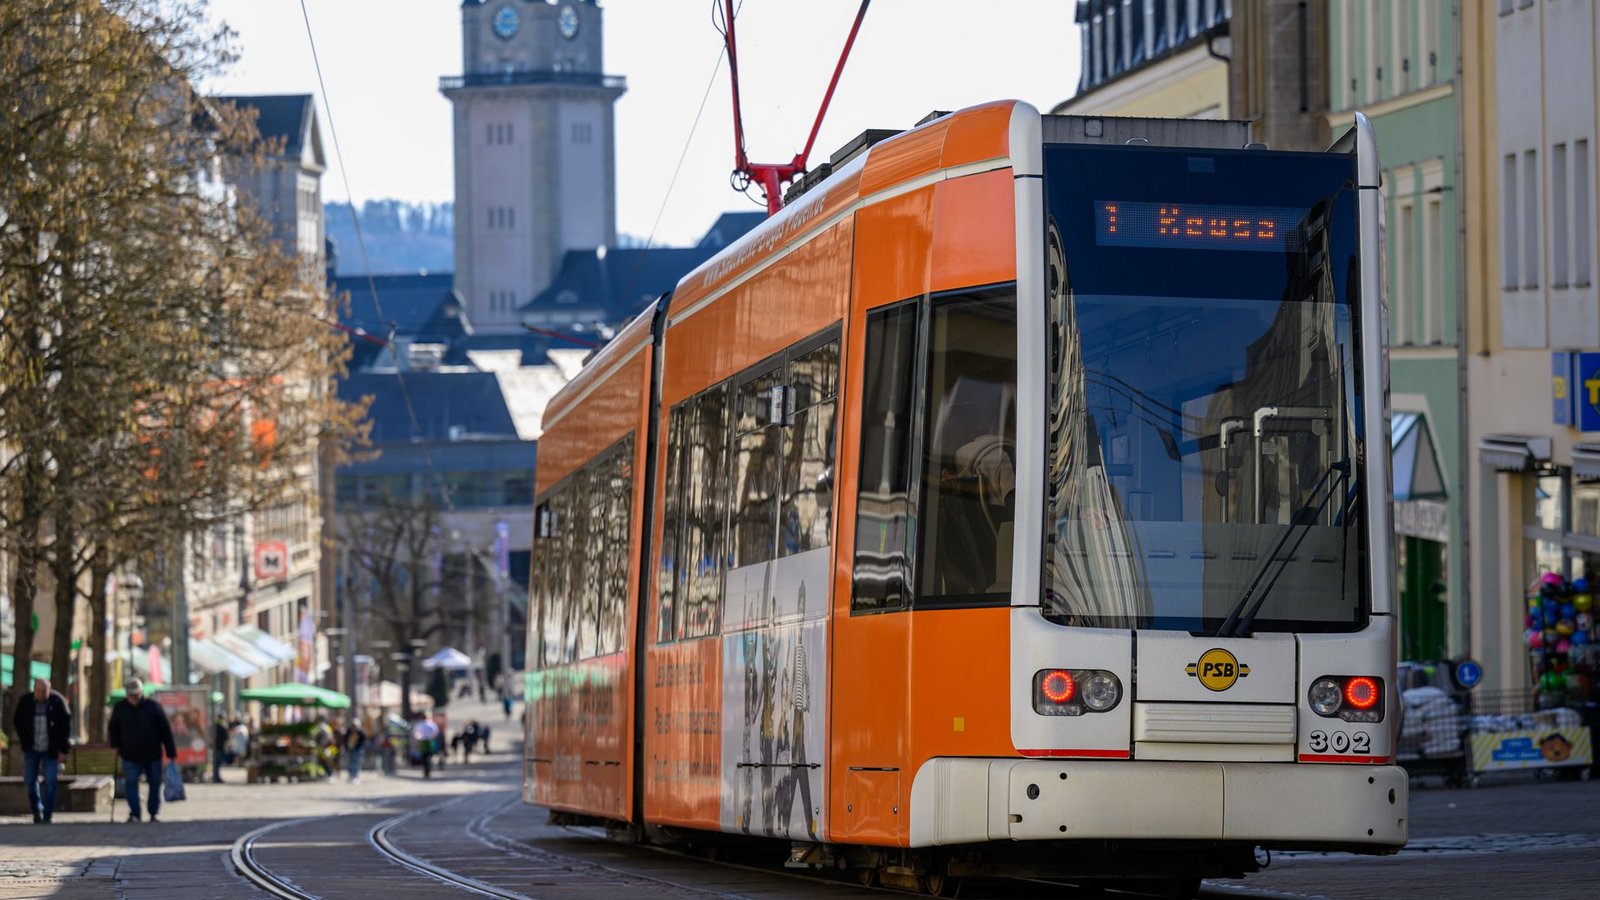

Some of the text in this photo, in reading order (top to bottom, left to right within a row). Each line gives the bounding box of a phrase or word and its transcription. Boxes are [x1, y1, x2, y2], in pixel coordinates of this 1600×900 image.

[1105, 205, 1117, 233] 1
[1203, 662, 1234, 678] PSB
[1308, 729, 1371, 754] 302
